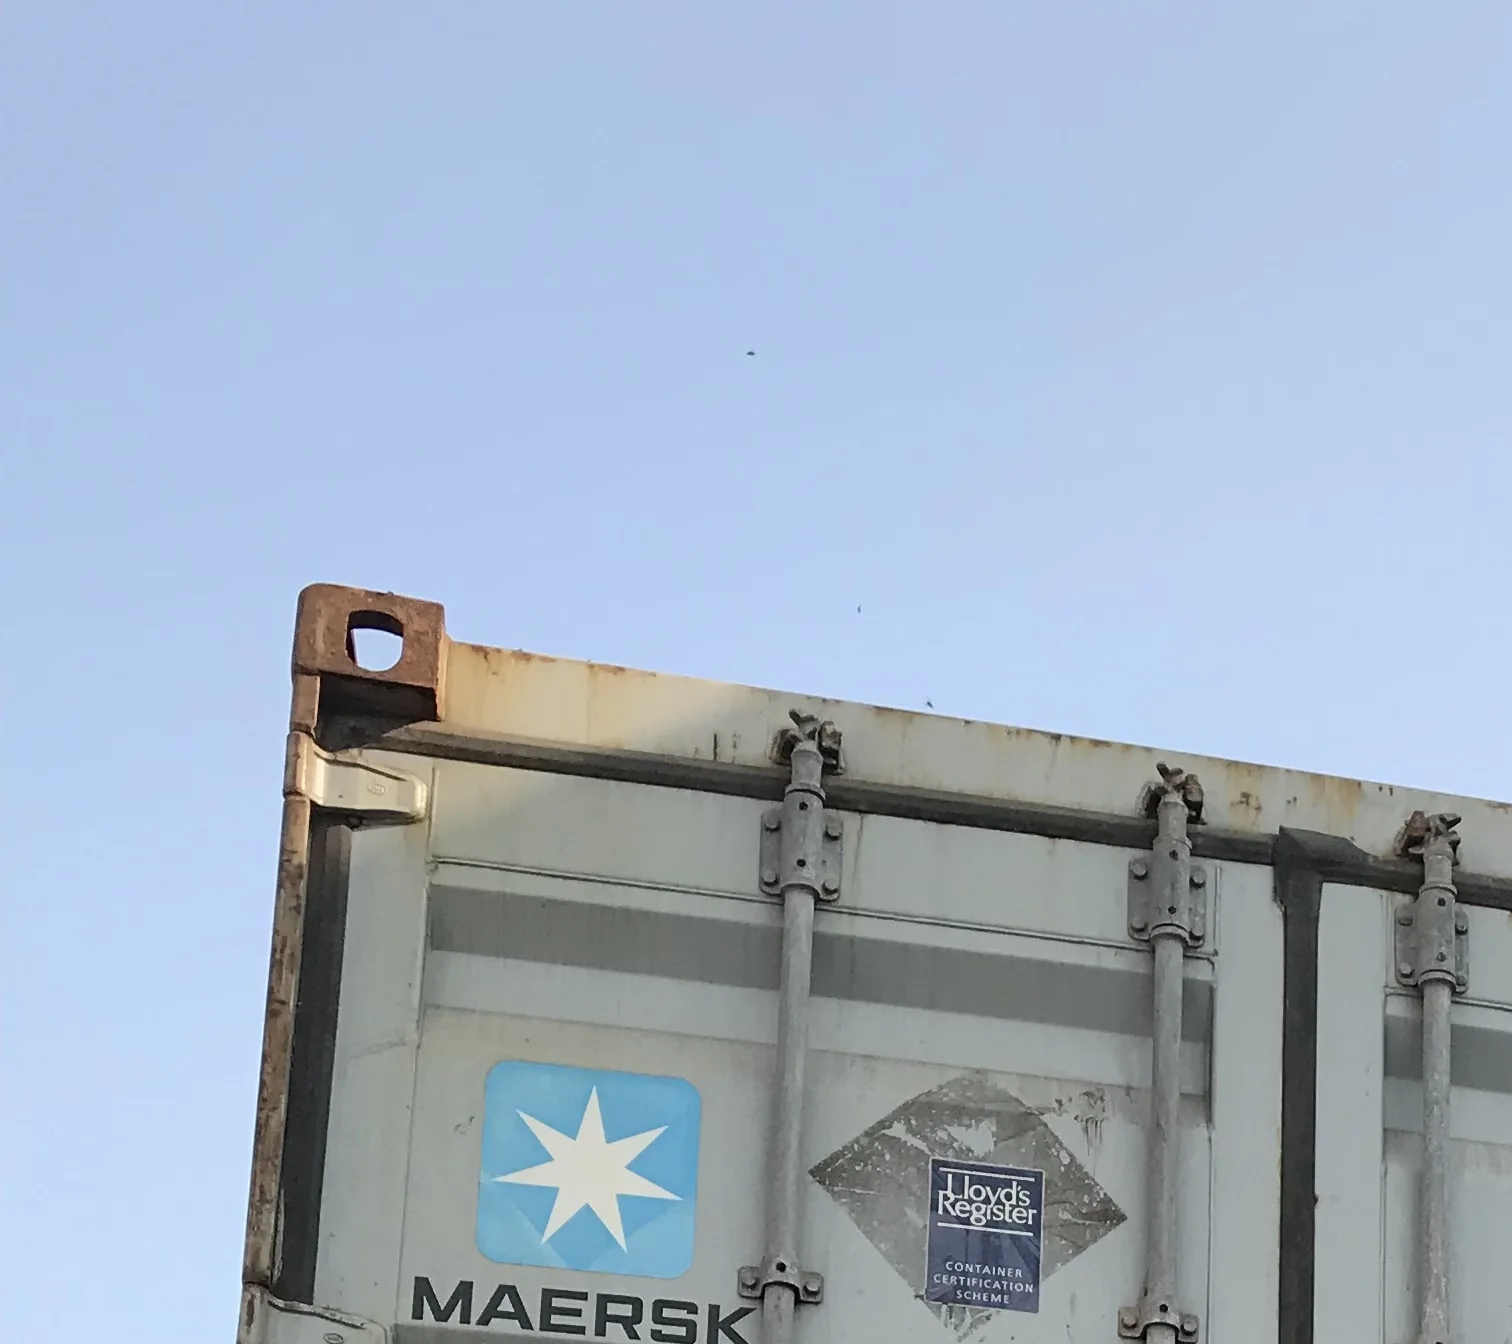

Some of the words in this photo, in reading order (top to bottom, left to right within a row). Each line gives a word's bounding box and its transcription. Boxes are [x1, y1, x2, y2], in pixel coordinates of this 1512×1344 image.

[947, 1174, 1031, 1206] Lloyd's
[938, 1190, 1038, 1226] Register
[945, 1261, 1023, 1278] CONTAINER
[933, 1273, 1034, 1293] CERTIFICATION
[956, 1289, 1010, 1304] SCHEME
